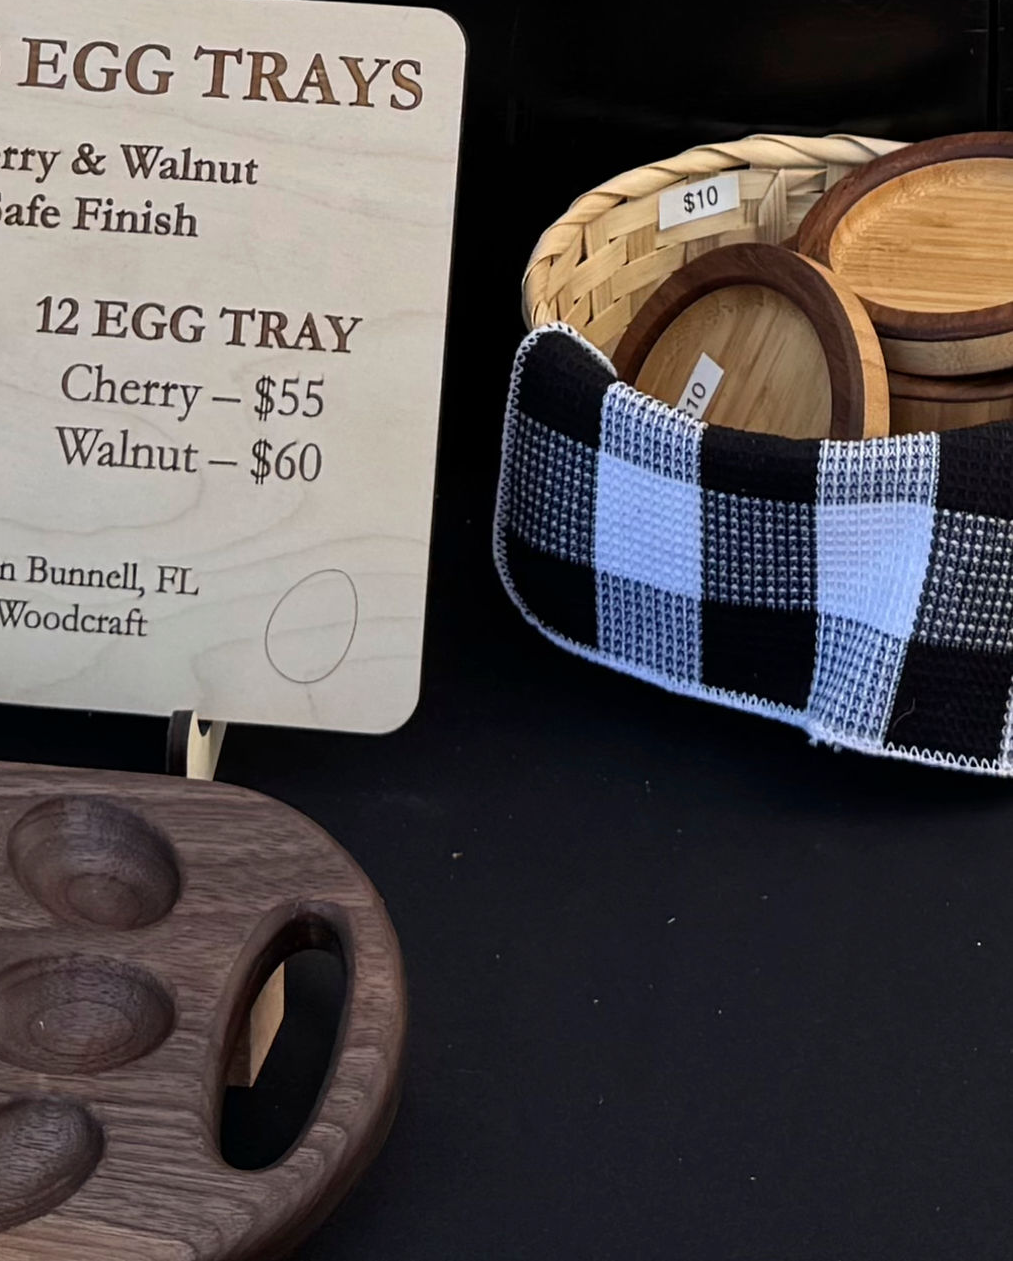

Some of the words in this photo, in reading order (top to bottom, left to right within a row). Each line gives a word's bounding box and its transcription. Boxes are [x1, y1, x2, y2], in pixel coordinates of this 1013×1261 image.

[16, 36, 175, 96] EGG
[193, 44, 424, 111] TRAYS
[70, 142, 107, 177] &
[119, 143, 259, 186] Walnut
[71, 196, 199, 238] Finish
[683, 185, 718, 214] $10
[35, 295, 80, 336] 12
[91, 299, 206, 344] EGG
[218, 306, 364, 354] TRAY
[60, 363, 204, 423] Cherry
[253, 374, 325, 423] $55
[682, 382, 706, 416] 10
[54, 425, 200, 474] Walnut
[249, 438, 323, 486] $60
[24, 555, 146, 599] Bunnell,
[154, 565, 200, 597] FL
